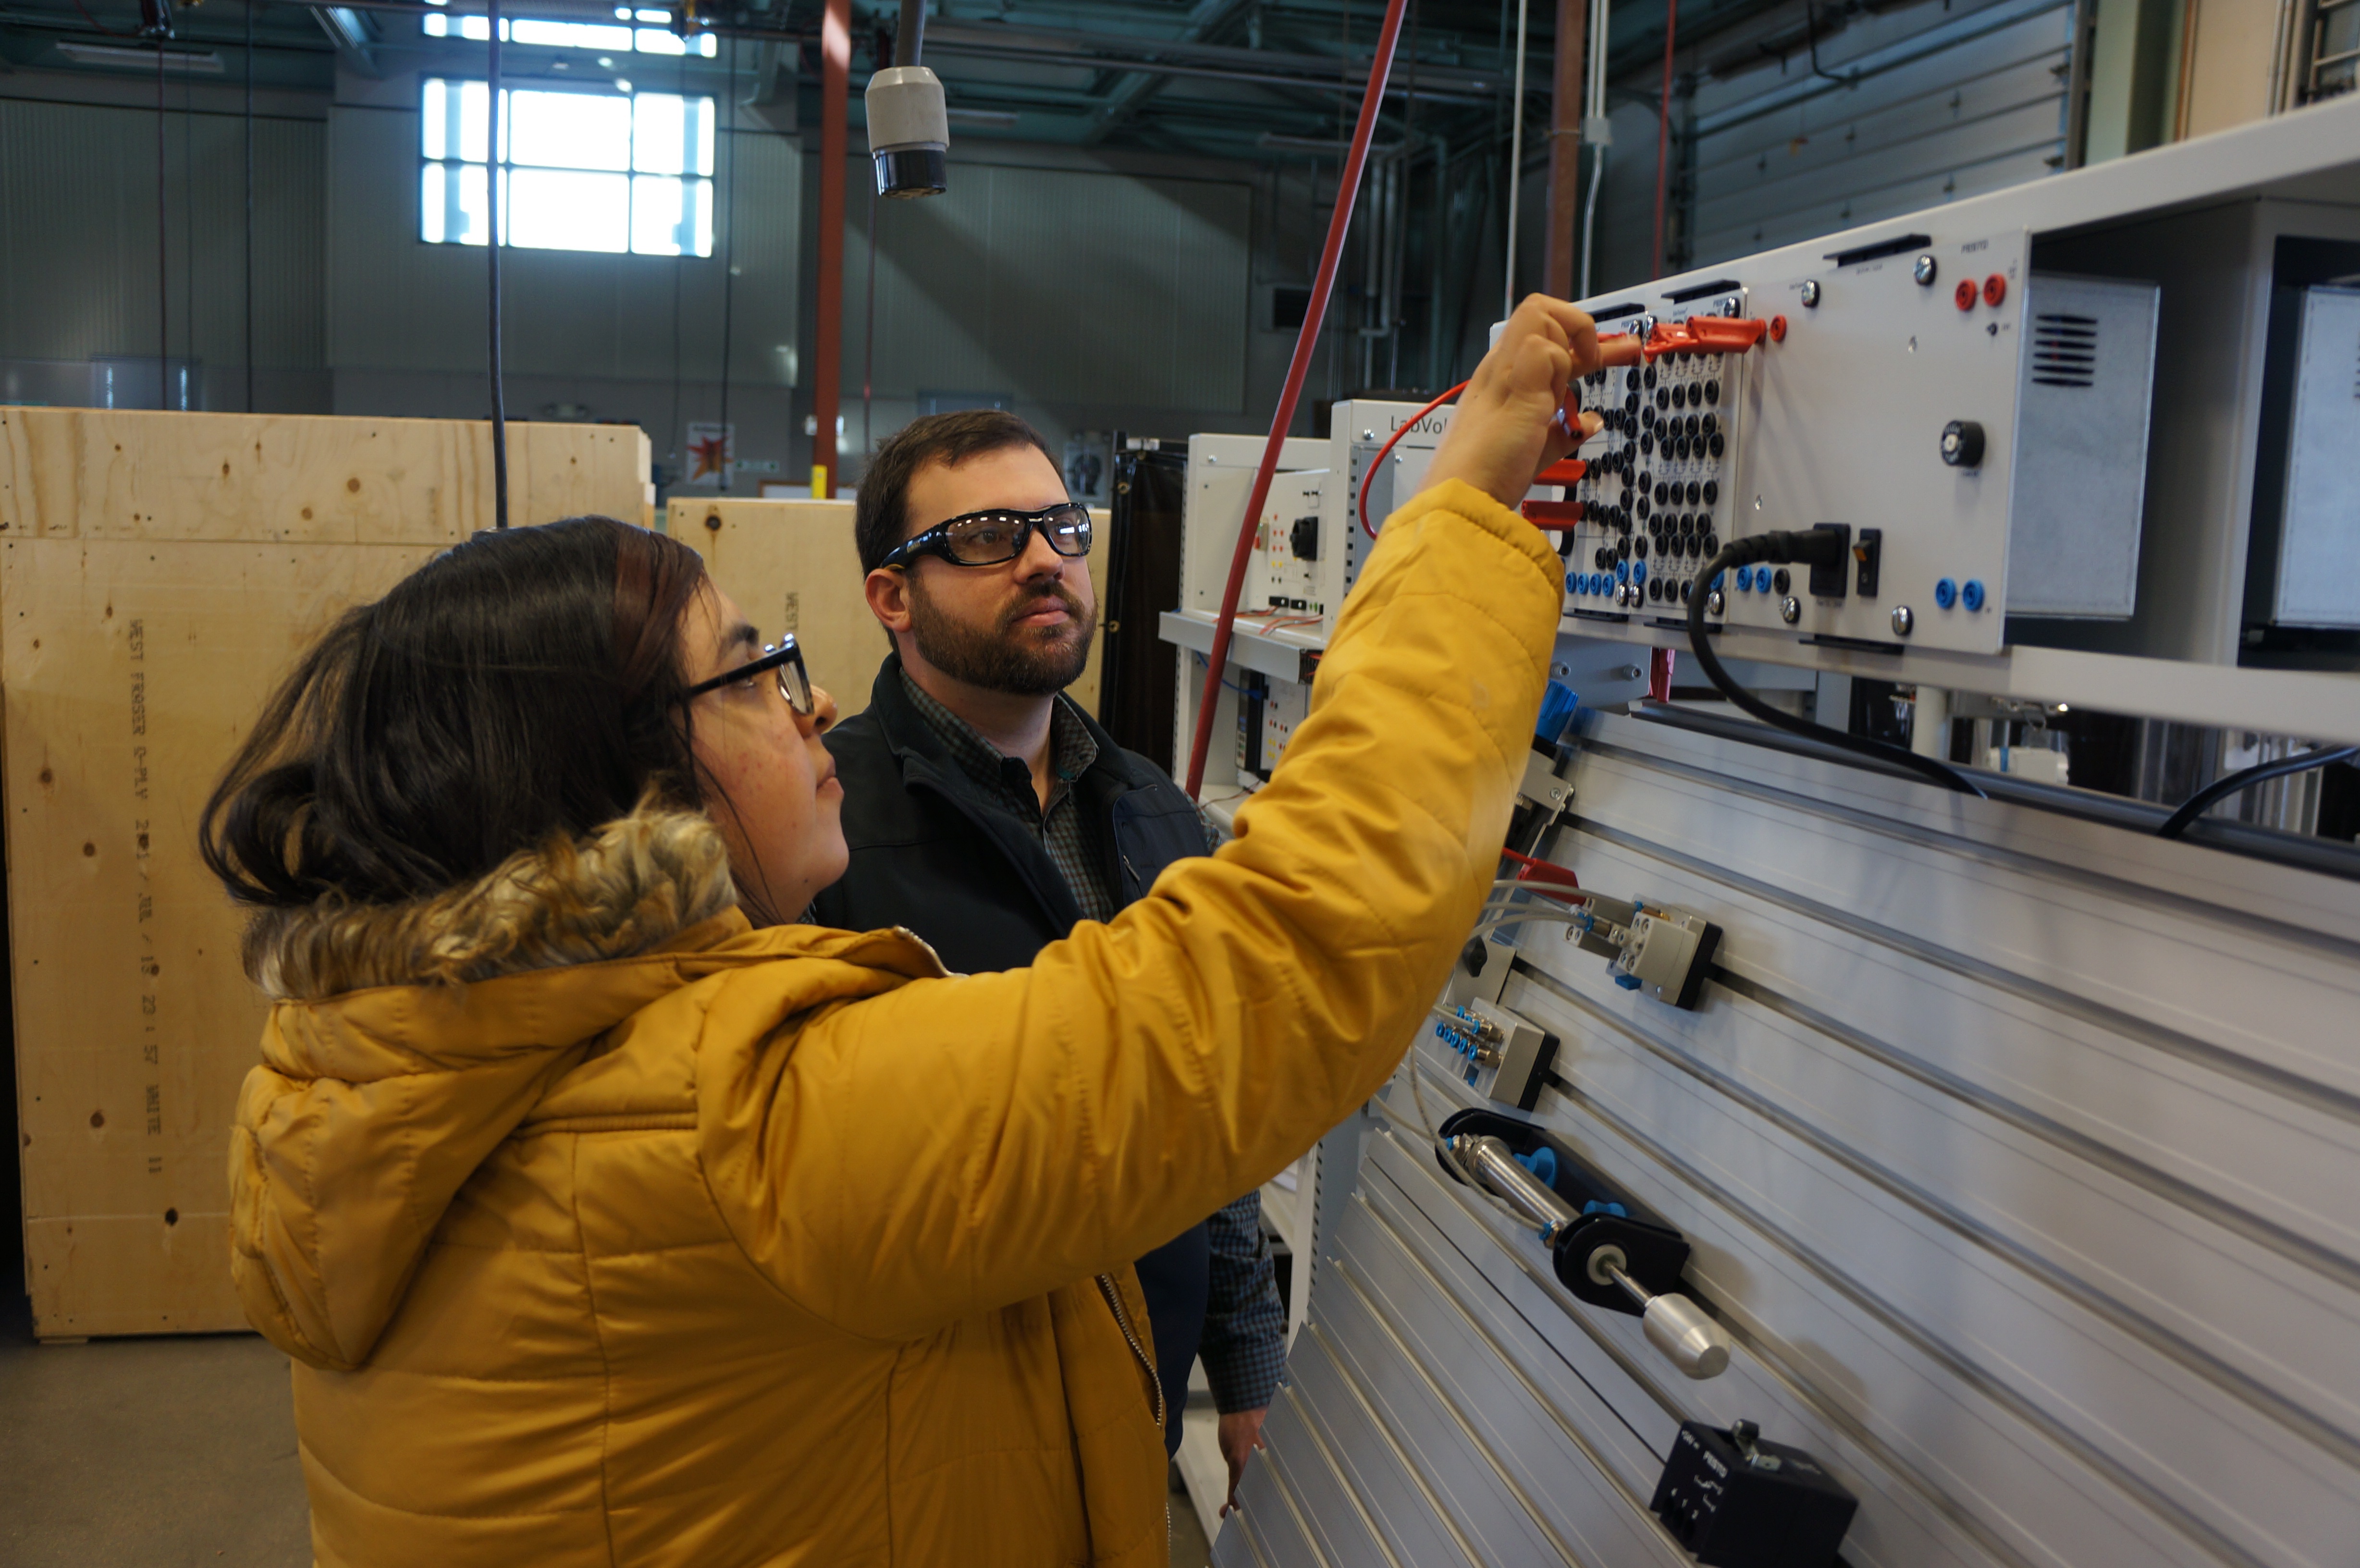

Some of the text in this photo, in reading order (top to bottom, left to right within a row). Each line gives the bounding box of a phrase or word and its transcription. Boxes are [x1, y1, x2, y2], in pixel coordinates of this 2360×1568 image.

[1390, 415, 1447, 434] LabVol
[785, 592, 799, 632] WEST
[129, 619, 144, 662] WEST
[130, 672, 146, 736] FRASER
[135, 819, 150, 860] 21
[144, 1044, 159, 1066] 57
[145, 1083, 161, 1136] WHITE
